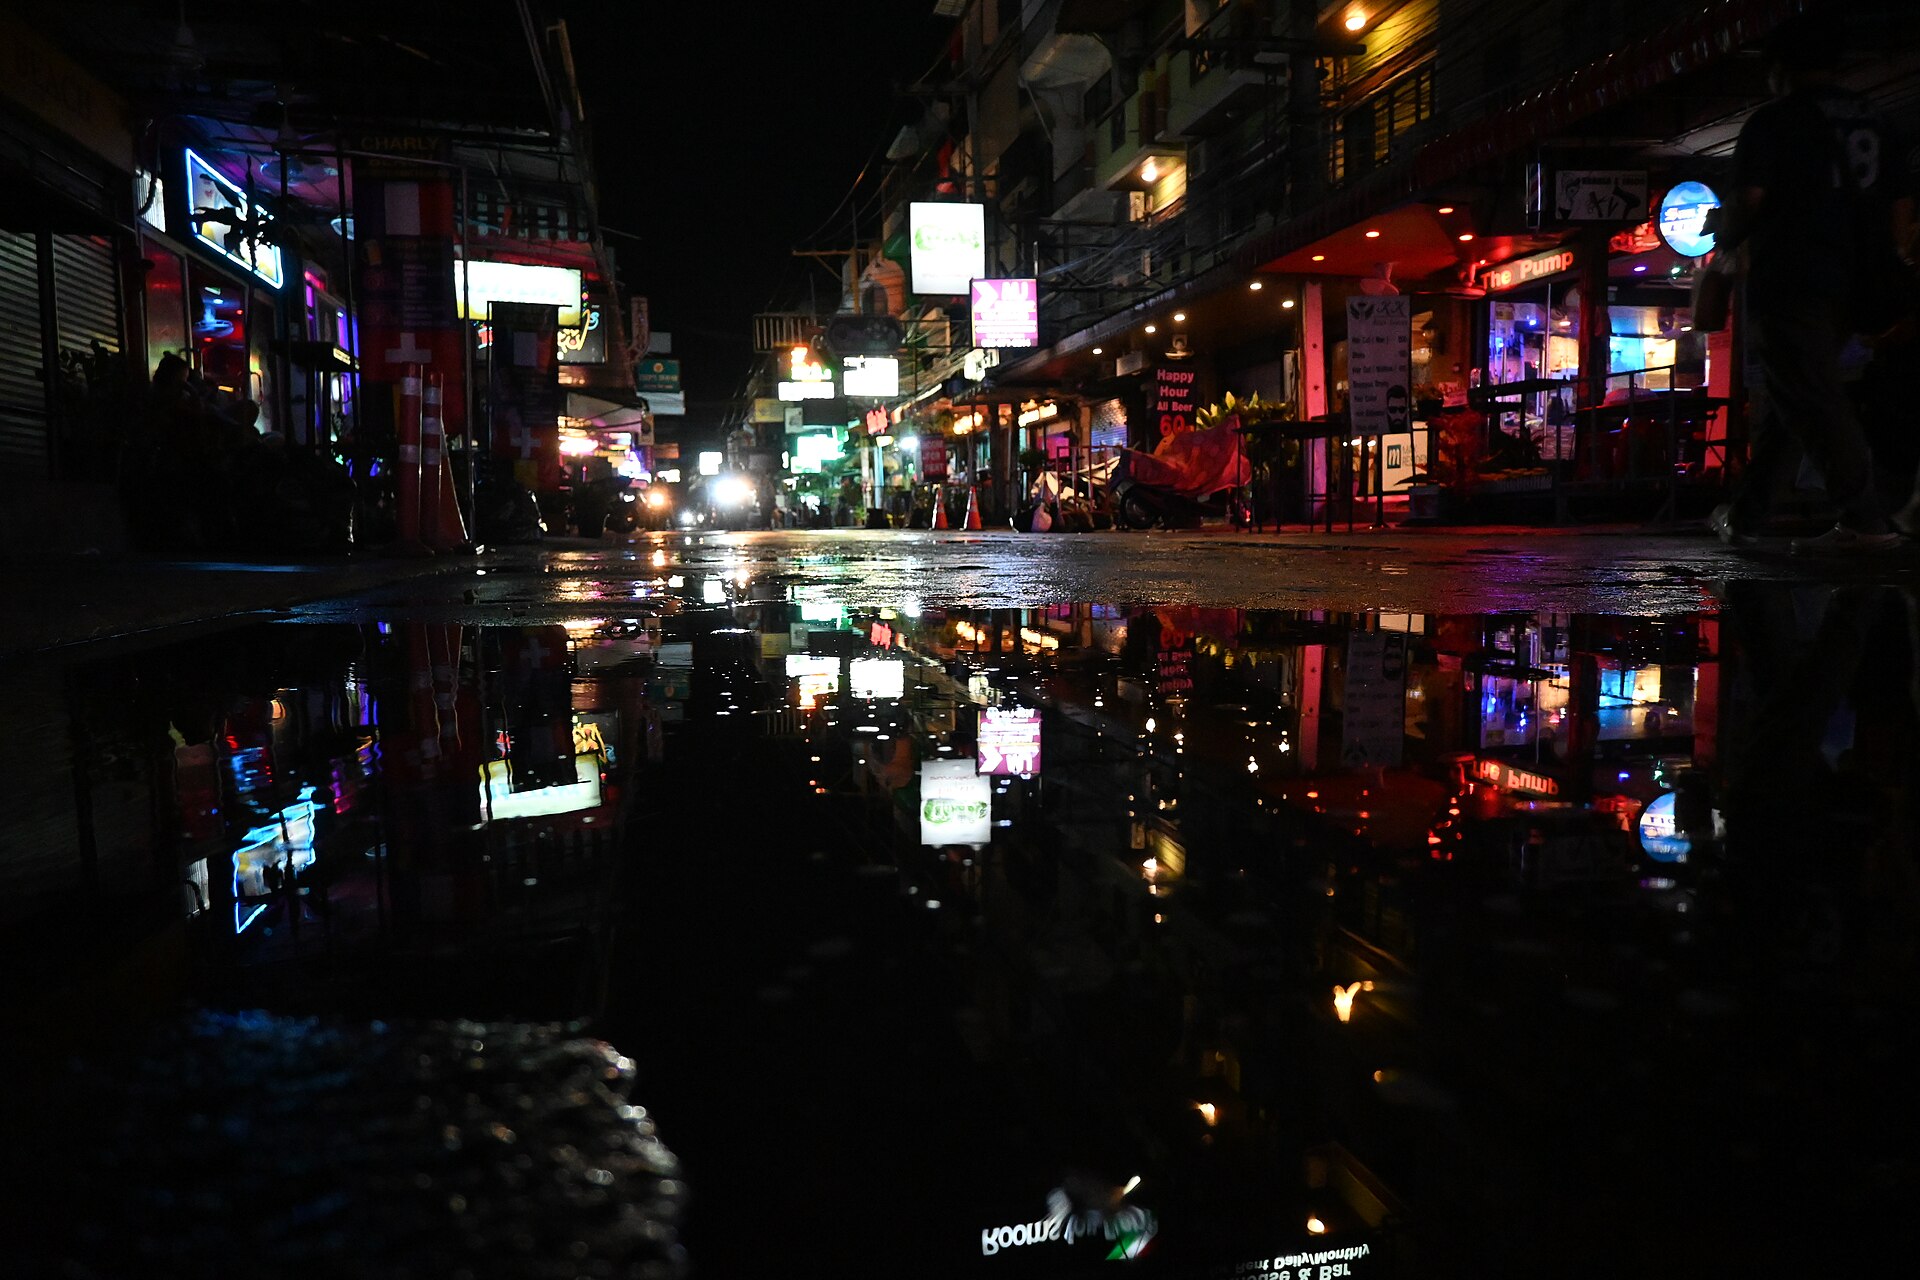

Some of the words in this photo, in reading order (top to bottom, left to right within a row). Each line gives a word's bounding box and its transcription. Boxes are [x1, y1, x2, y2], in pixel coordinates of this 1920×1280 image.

[360, 136, 440, 151] CHARLY
[1480, 268, 1512, 290] The
[1519, 251, 1574, 280] Pump
[1157, 369, 1194, 384] Happy
[1160, 386, 1189, 397] Hour
[1157, 401, 1168, 411] All
[1172, 401, 1193, 412] Beer
